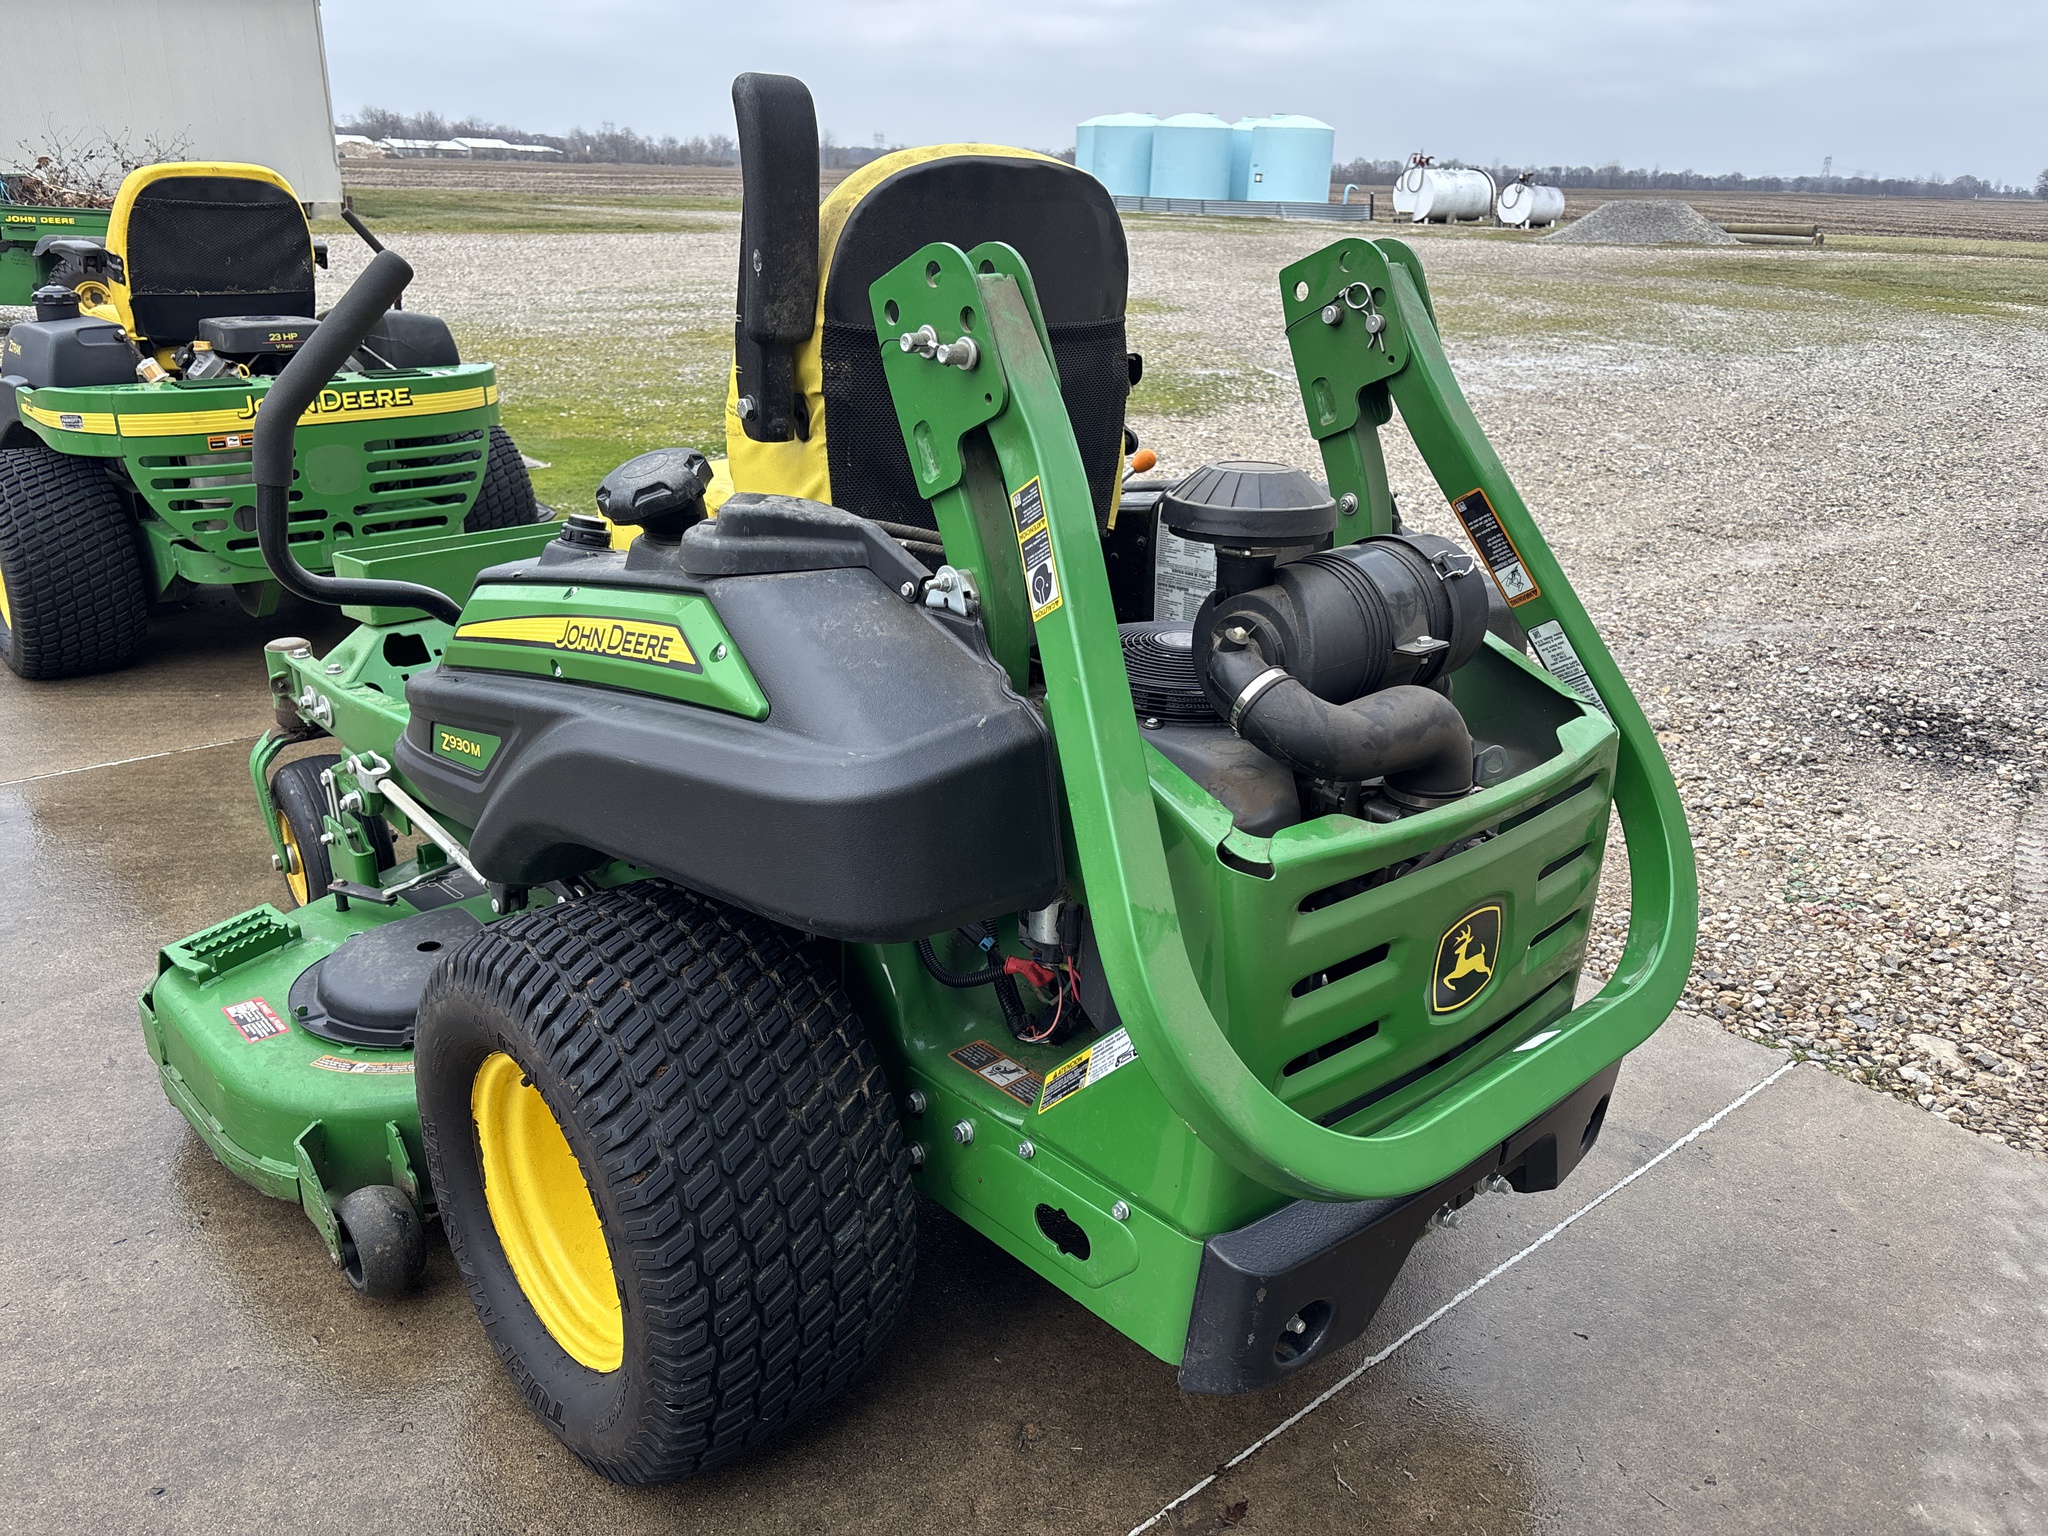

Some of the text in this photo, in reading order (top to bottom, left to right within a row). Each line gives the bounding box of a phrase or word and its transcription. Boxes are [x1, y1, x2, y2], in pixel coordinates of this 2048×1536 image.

[5, 215, 76, 225] JOHN DEERE
[268, 332, 298, 341] 23 HP
[319, 387, 413, 413] DEERE
[1034, 600, 1055, 618] CAUTION
[557, 620, 674, 659] JOHN DEERE
[440, 732, 481, 758] Z930M
[494, 1335, 567, 1432] TURF
